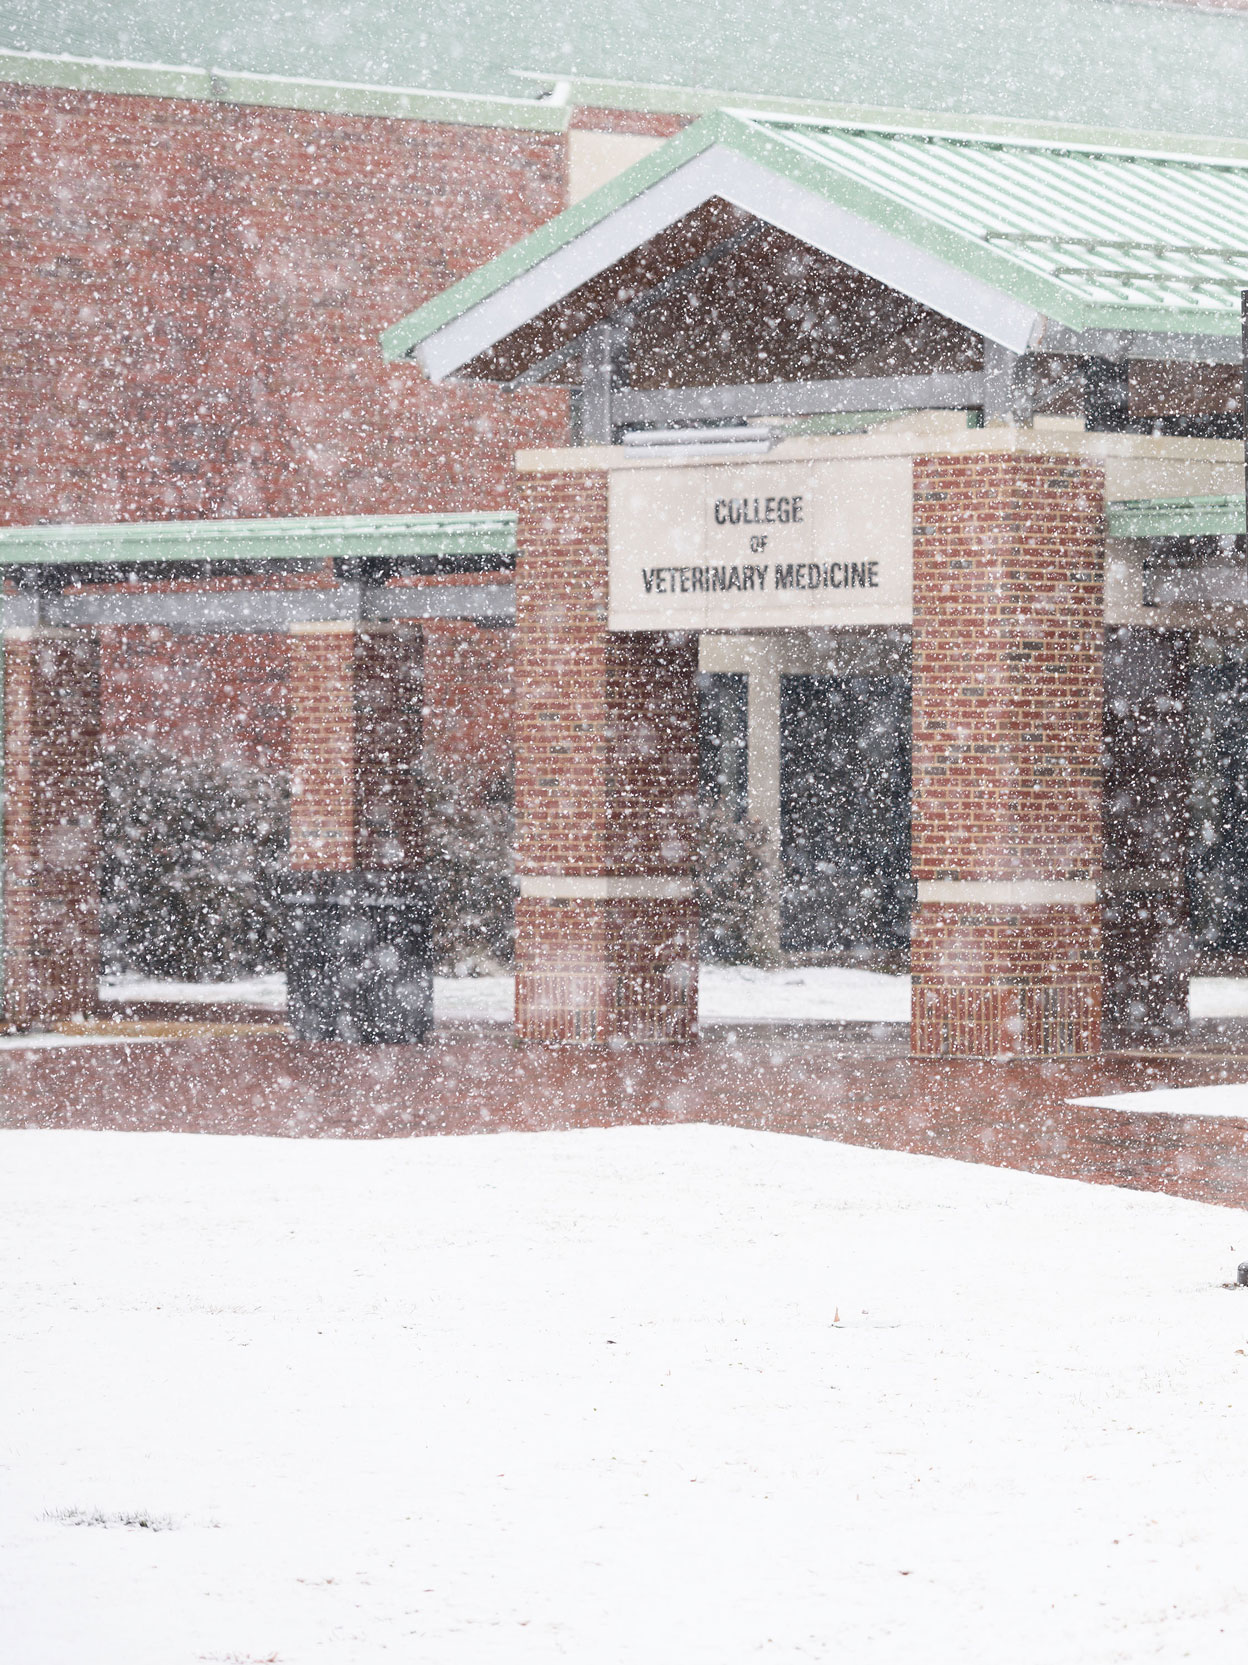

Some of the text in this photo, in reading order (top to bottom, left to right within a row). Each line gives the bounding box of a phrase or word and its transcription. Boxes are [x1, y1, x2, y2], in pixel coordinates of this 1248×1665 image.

[714, 496, 804, 525] COLLEGE
[750, 535, 768, 553] OF
[642, 561, 879, 593] VETERINARY MEDICINE
